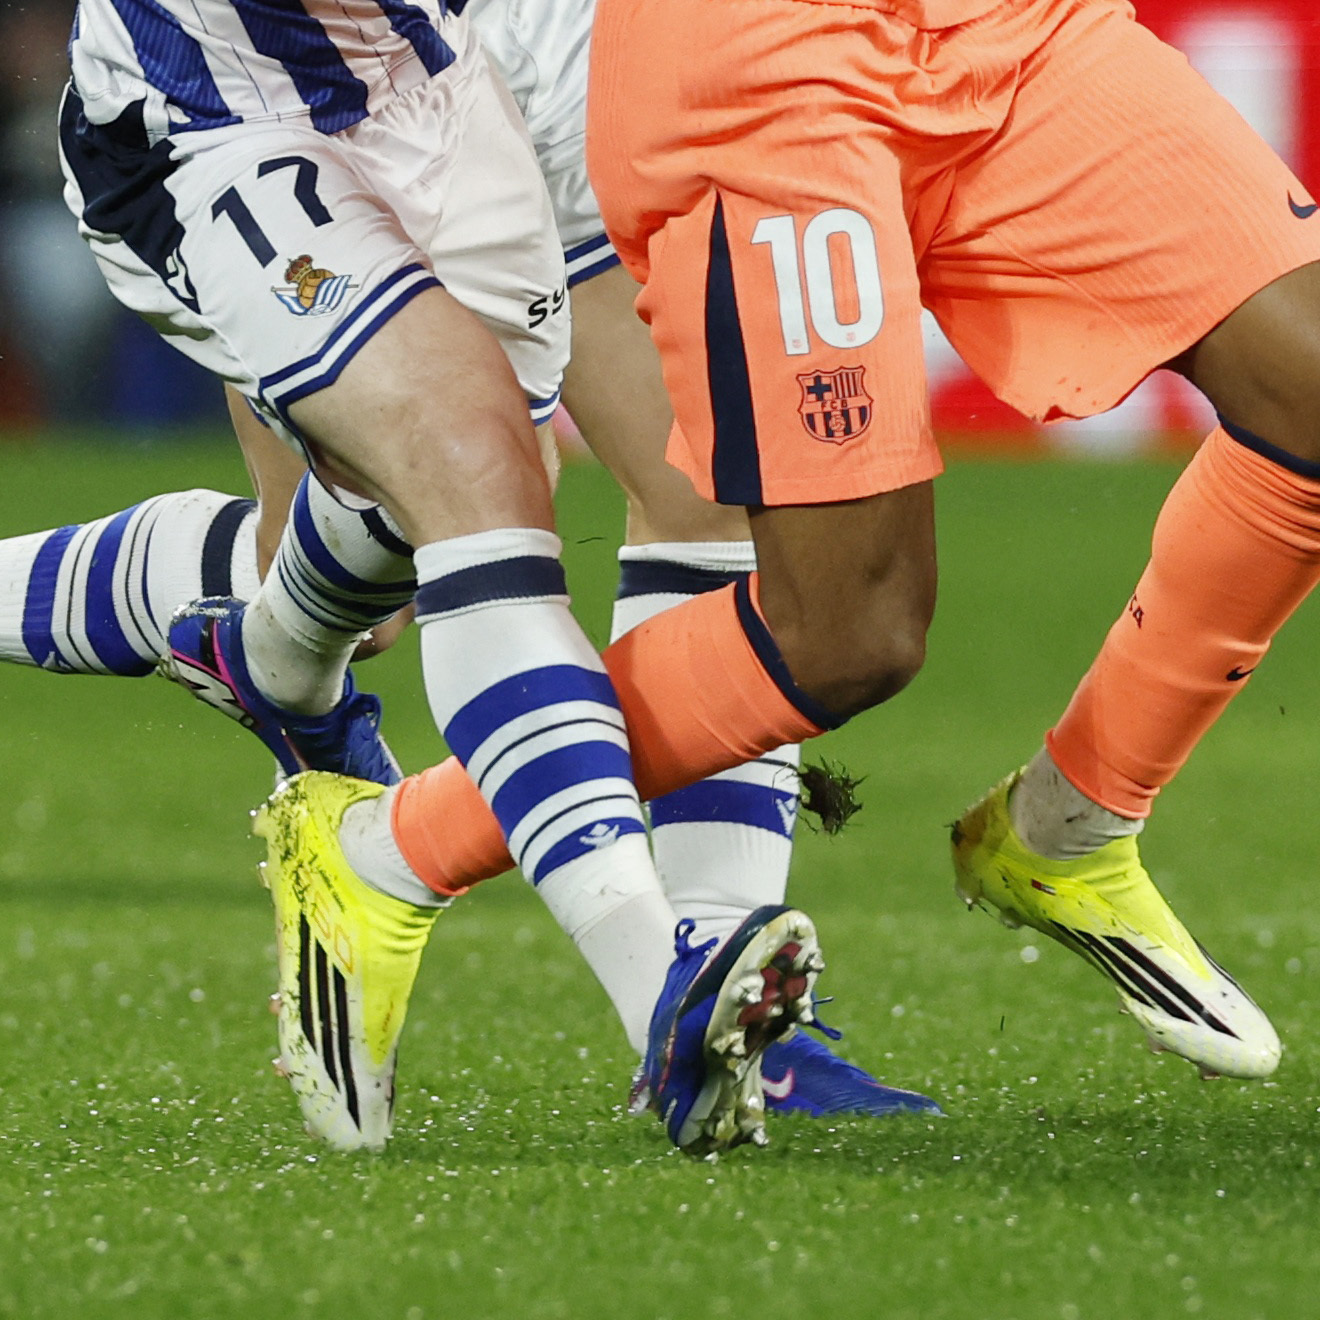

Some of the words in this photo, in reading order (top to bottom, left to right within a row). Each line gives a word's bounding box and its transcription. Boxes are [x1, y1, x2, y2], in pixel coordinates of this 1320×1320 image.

[211, 155, 334, 269] 17
[750, 207, 885, 357] 10
[820, 399, 848, 410] FCB
